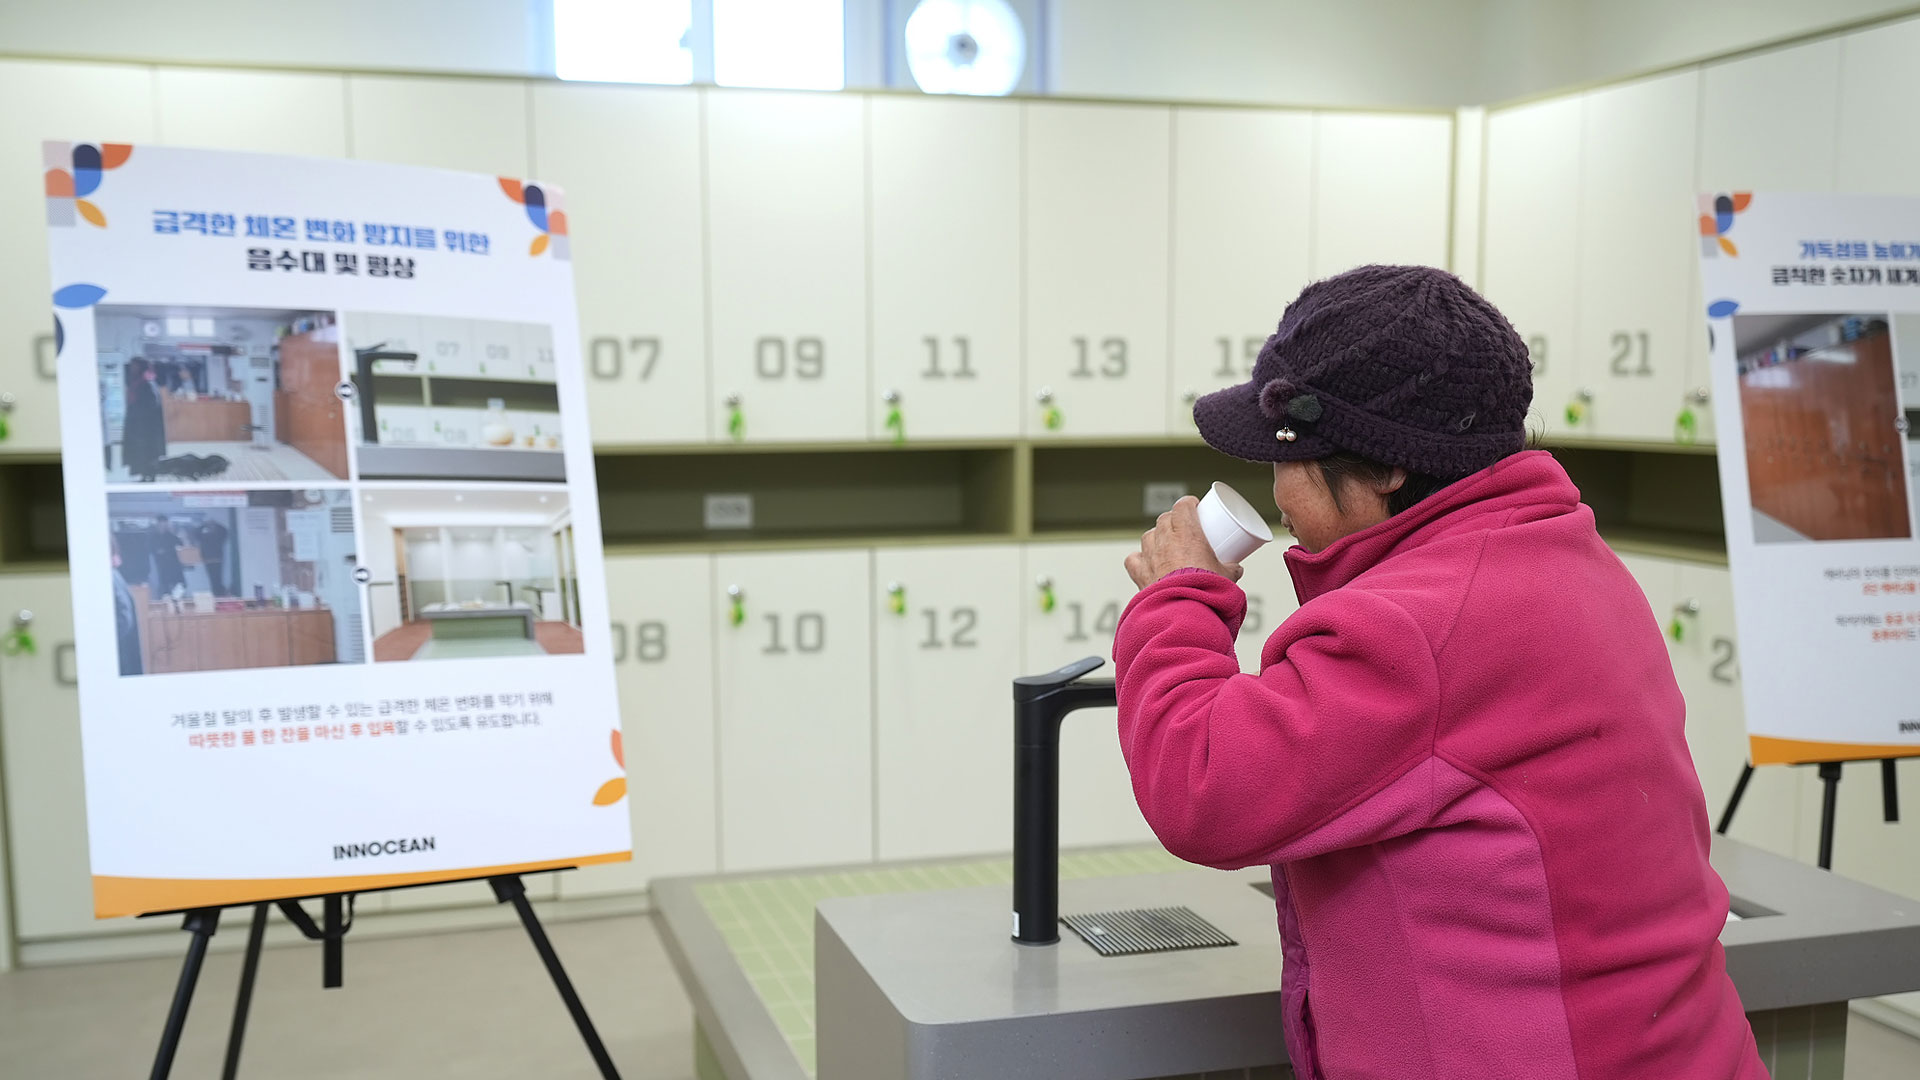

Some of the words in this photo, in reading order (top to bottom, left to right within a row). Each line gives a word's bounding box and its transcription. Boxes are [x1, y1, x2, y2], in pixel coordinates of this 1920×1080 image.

[153, 210, 236, 237] 급격한
[245, 214, 297, 240] 체온
[304, 217, 356, 244] 변화
[363, 223, 437, 250] 방지를
[444, 229, 491, 255] 위한
[247, 248, 327, 273] 음수대
[334, 253, 358, 276] 및
[367, 255, 415, 279] 평상
[1830, 267, 1882, 286] 숫자가
[589, 335, 661, 381] 07
[755, 335, 825, 380] 09
[920, 335, 978, 380] 11
[1068, 336, 1130, 379] 13
[1213, 336, 1264, 379] 15
[1609, 331, 1654, 377] 21
[609, 621, 668, 664] 08
[761, 612, 826, 656] 10
[919, 607, 979, 651] 12
[1063, 601, 1121, 643] 14
[171, 711, 217, 728] 겨울철
[222, 708, 253, 726] 탈의
[259, 707, 271, 723] 후
[277, 703, 321, 722] 발생할
[326, 704, 340, 719] 수
[344, 701, 373, 717] 있는
[378, 698, 419, 716] 급격한
[454, 694, 494, 712] 변화를
[528, 691, 553, 706] 위해
[188, 731, 237, 749] 따뜻한
[242, 729, 256, 746] 물
[262, 727, 276, 745] 한
[314, 723, 345, 741] 마신
[350, 722, 362, 738] 후
[366, 718, 409, 737] 입욕할
[413, 718, 427, 734] 수
[430, 716, 472, 732] 있도록
[333, 836, 436, 860] INNOCEAN
